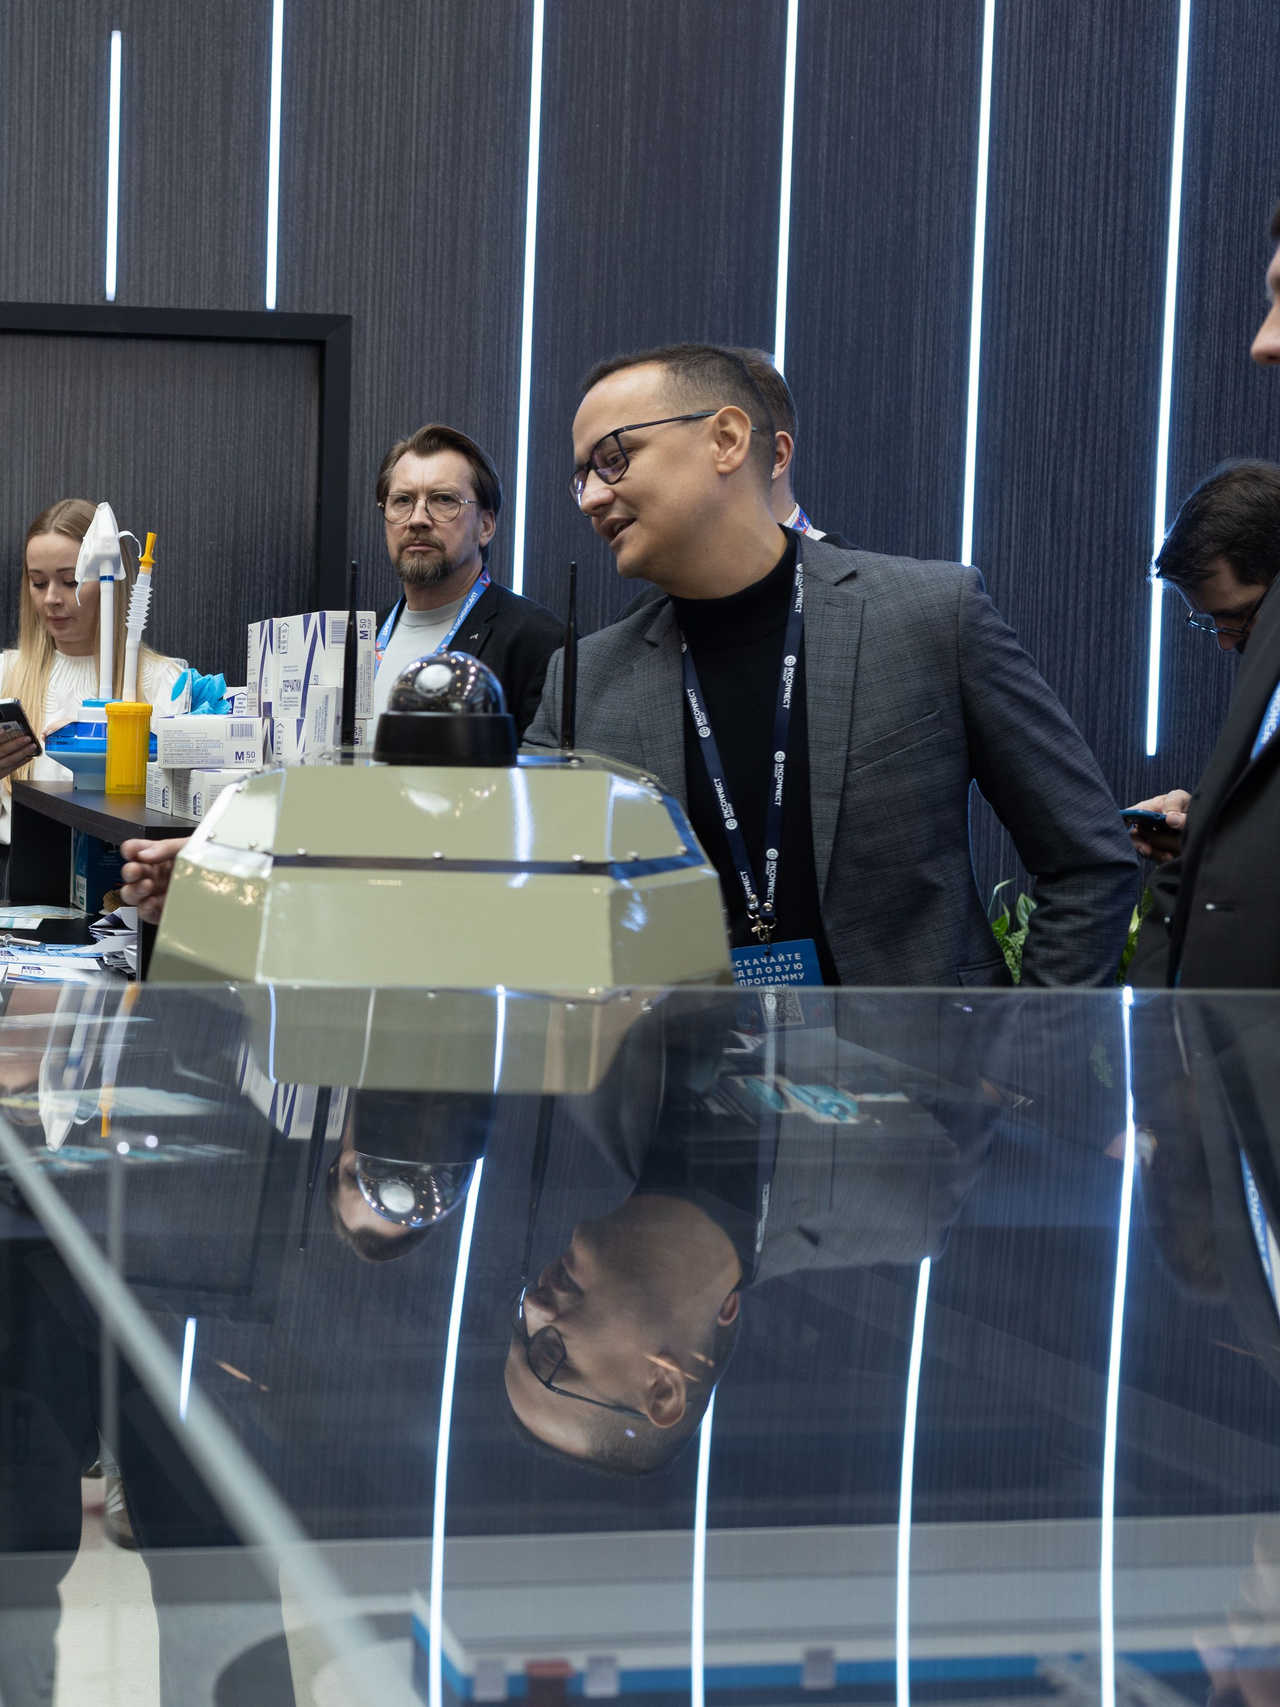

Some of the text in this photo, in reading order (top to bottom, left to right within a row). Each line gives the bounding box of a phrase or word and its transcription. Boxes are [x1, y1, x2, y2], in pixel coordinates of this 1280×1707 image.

[359, 618, 367, 628] 50
[453, 591, 479, 631] ГОСКОНСАЛТ
[687, 688, 703, 727] INCONNECT
[782, 667, 795, 709] INCONNECT
[234, 751, 256, 761] M 50
[713, 778, 731, 819] INCONNECT
[774, 763, 785, 807] INCONNECT
[766, 860, 778, 904] INCONNECT
[735, 952, 802, 968] СКАЧАЙТЕ
[737, 962, 804, 979] ДЕЛОВУЮ
[739, 972, 805, 987] ПРОГРАММУ
